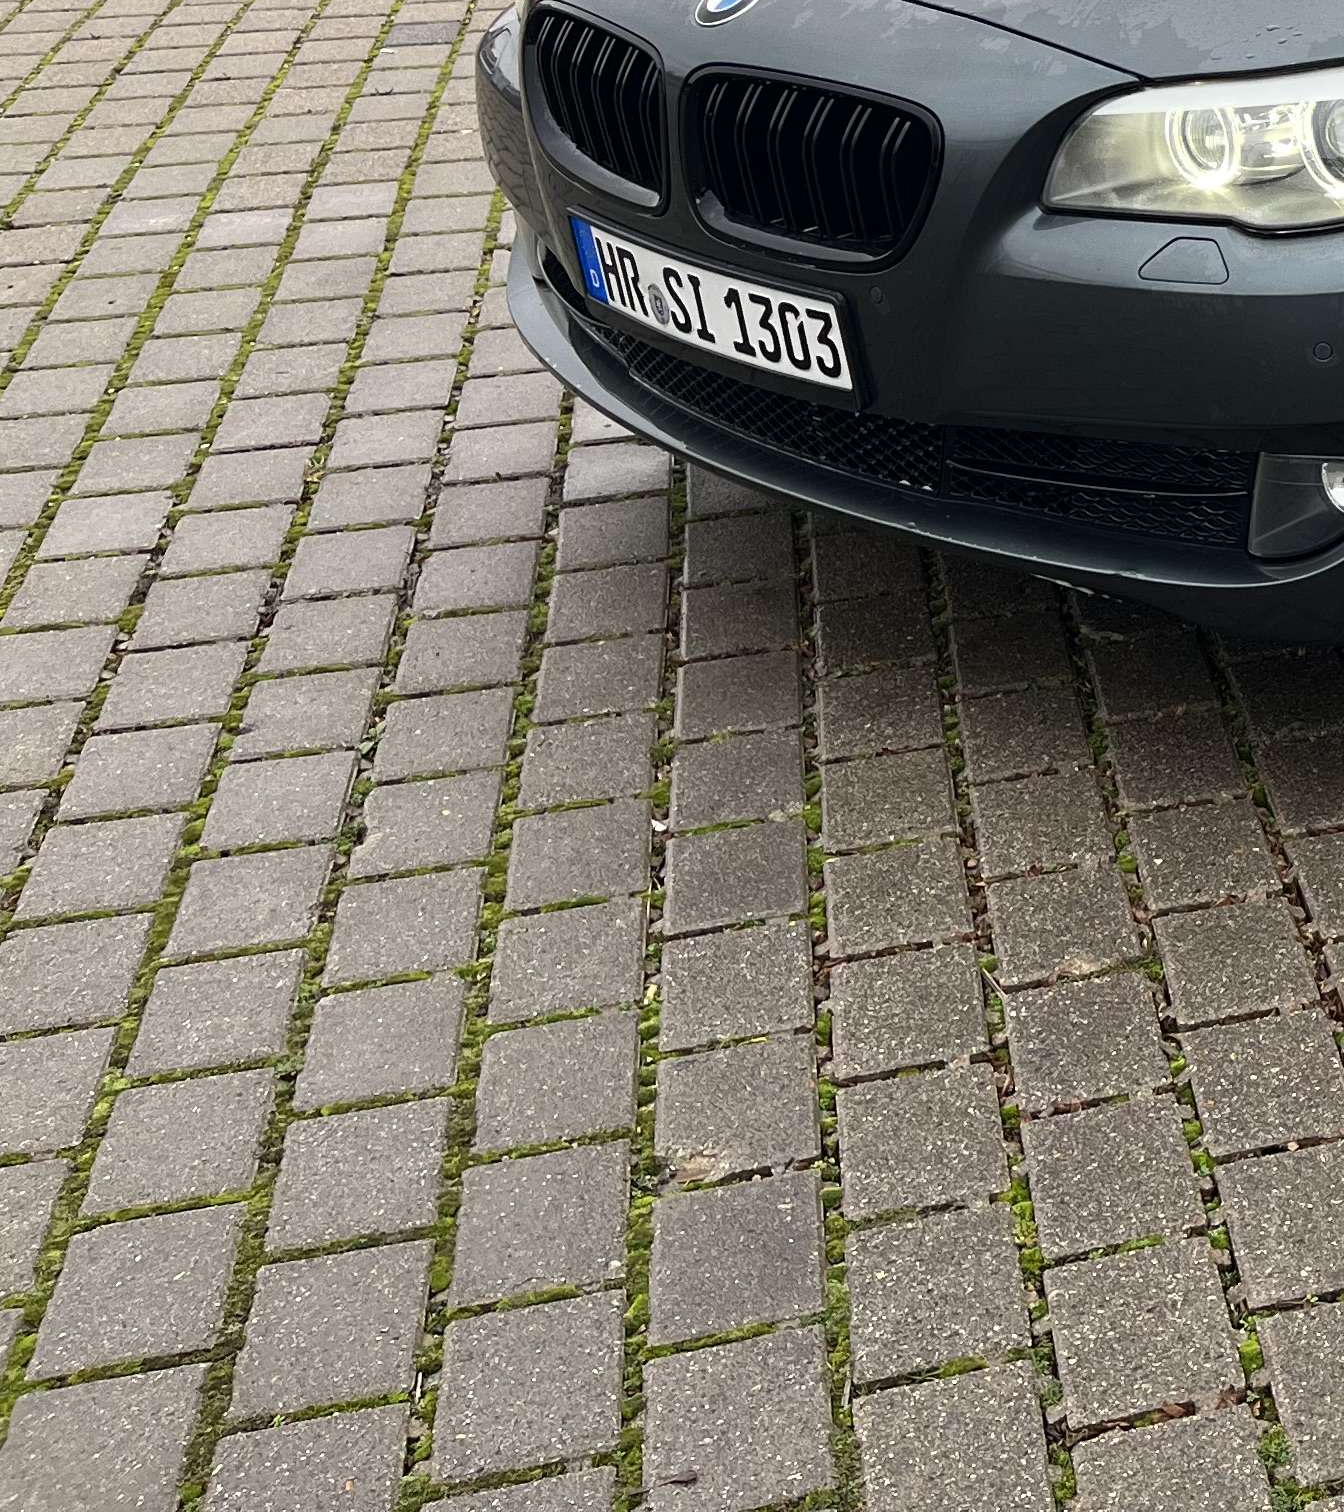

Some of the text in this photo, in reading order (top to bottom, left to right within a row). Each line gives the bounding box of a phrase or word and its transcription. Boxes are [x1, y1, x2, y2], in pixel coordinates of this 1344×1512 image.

[590, 269, 600, 288] D
[595, 237, 842, 378] HR SI 1303
